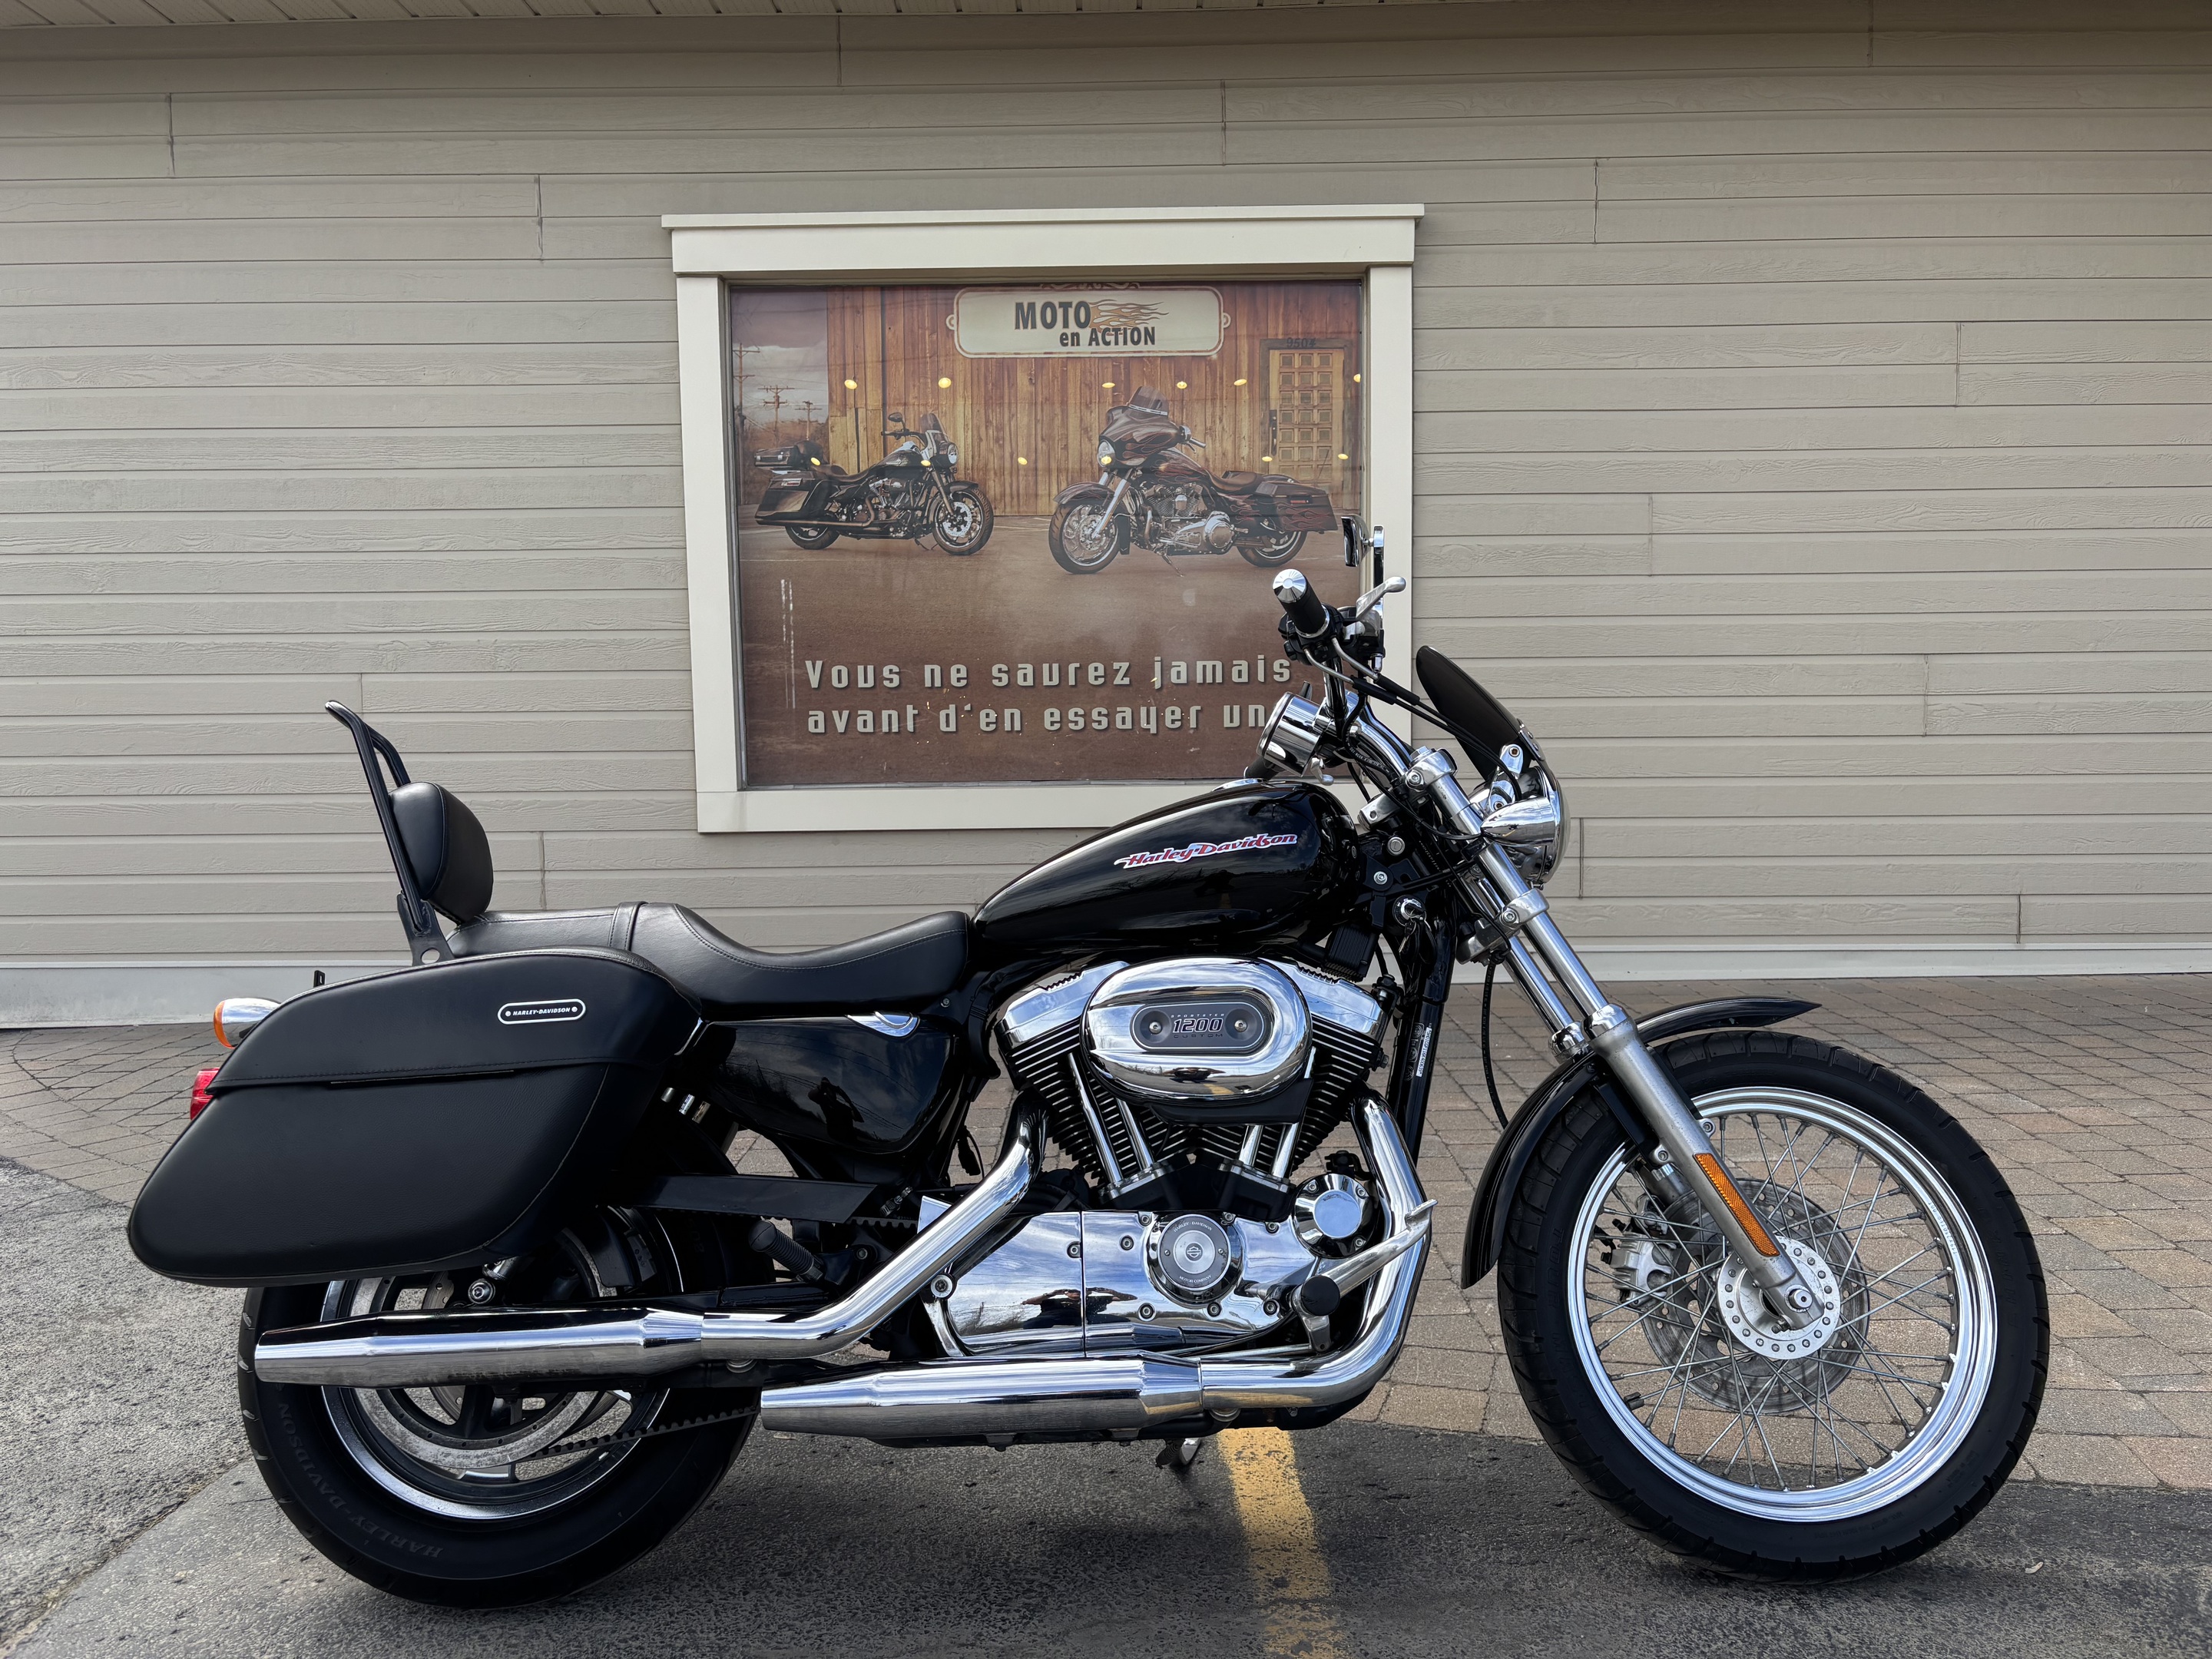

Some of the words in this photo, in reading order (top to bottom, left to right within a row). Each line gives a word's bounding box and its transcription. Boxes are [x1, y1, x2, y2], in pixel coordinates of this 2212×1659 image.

[1014, 300, 1091, 330] MOTO
[1059, 331, 1081, 347] en
[1089, 326, 1156, 346] ACTION
[1286, 337, 1316, 348] 9504
[805, 660, 901, 688] Vous
[924, 664, 968, 687] ne
[992, 661, 1131, 687] saurez
[1154, 654, 1291, 690] jamais
[808, 704, 919, 733] avant
[1044, 706, 1202, 734] essayer
[512, 1007, 571, 1016] HARLEY-DAVIDSON
[1172, 1018, 1224, 1033] 1200
